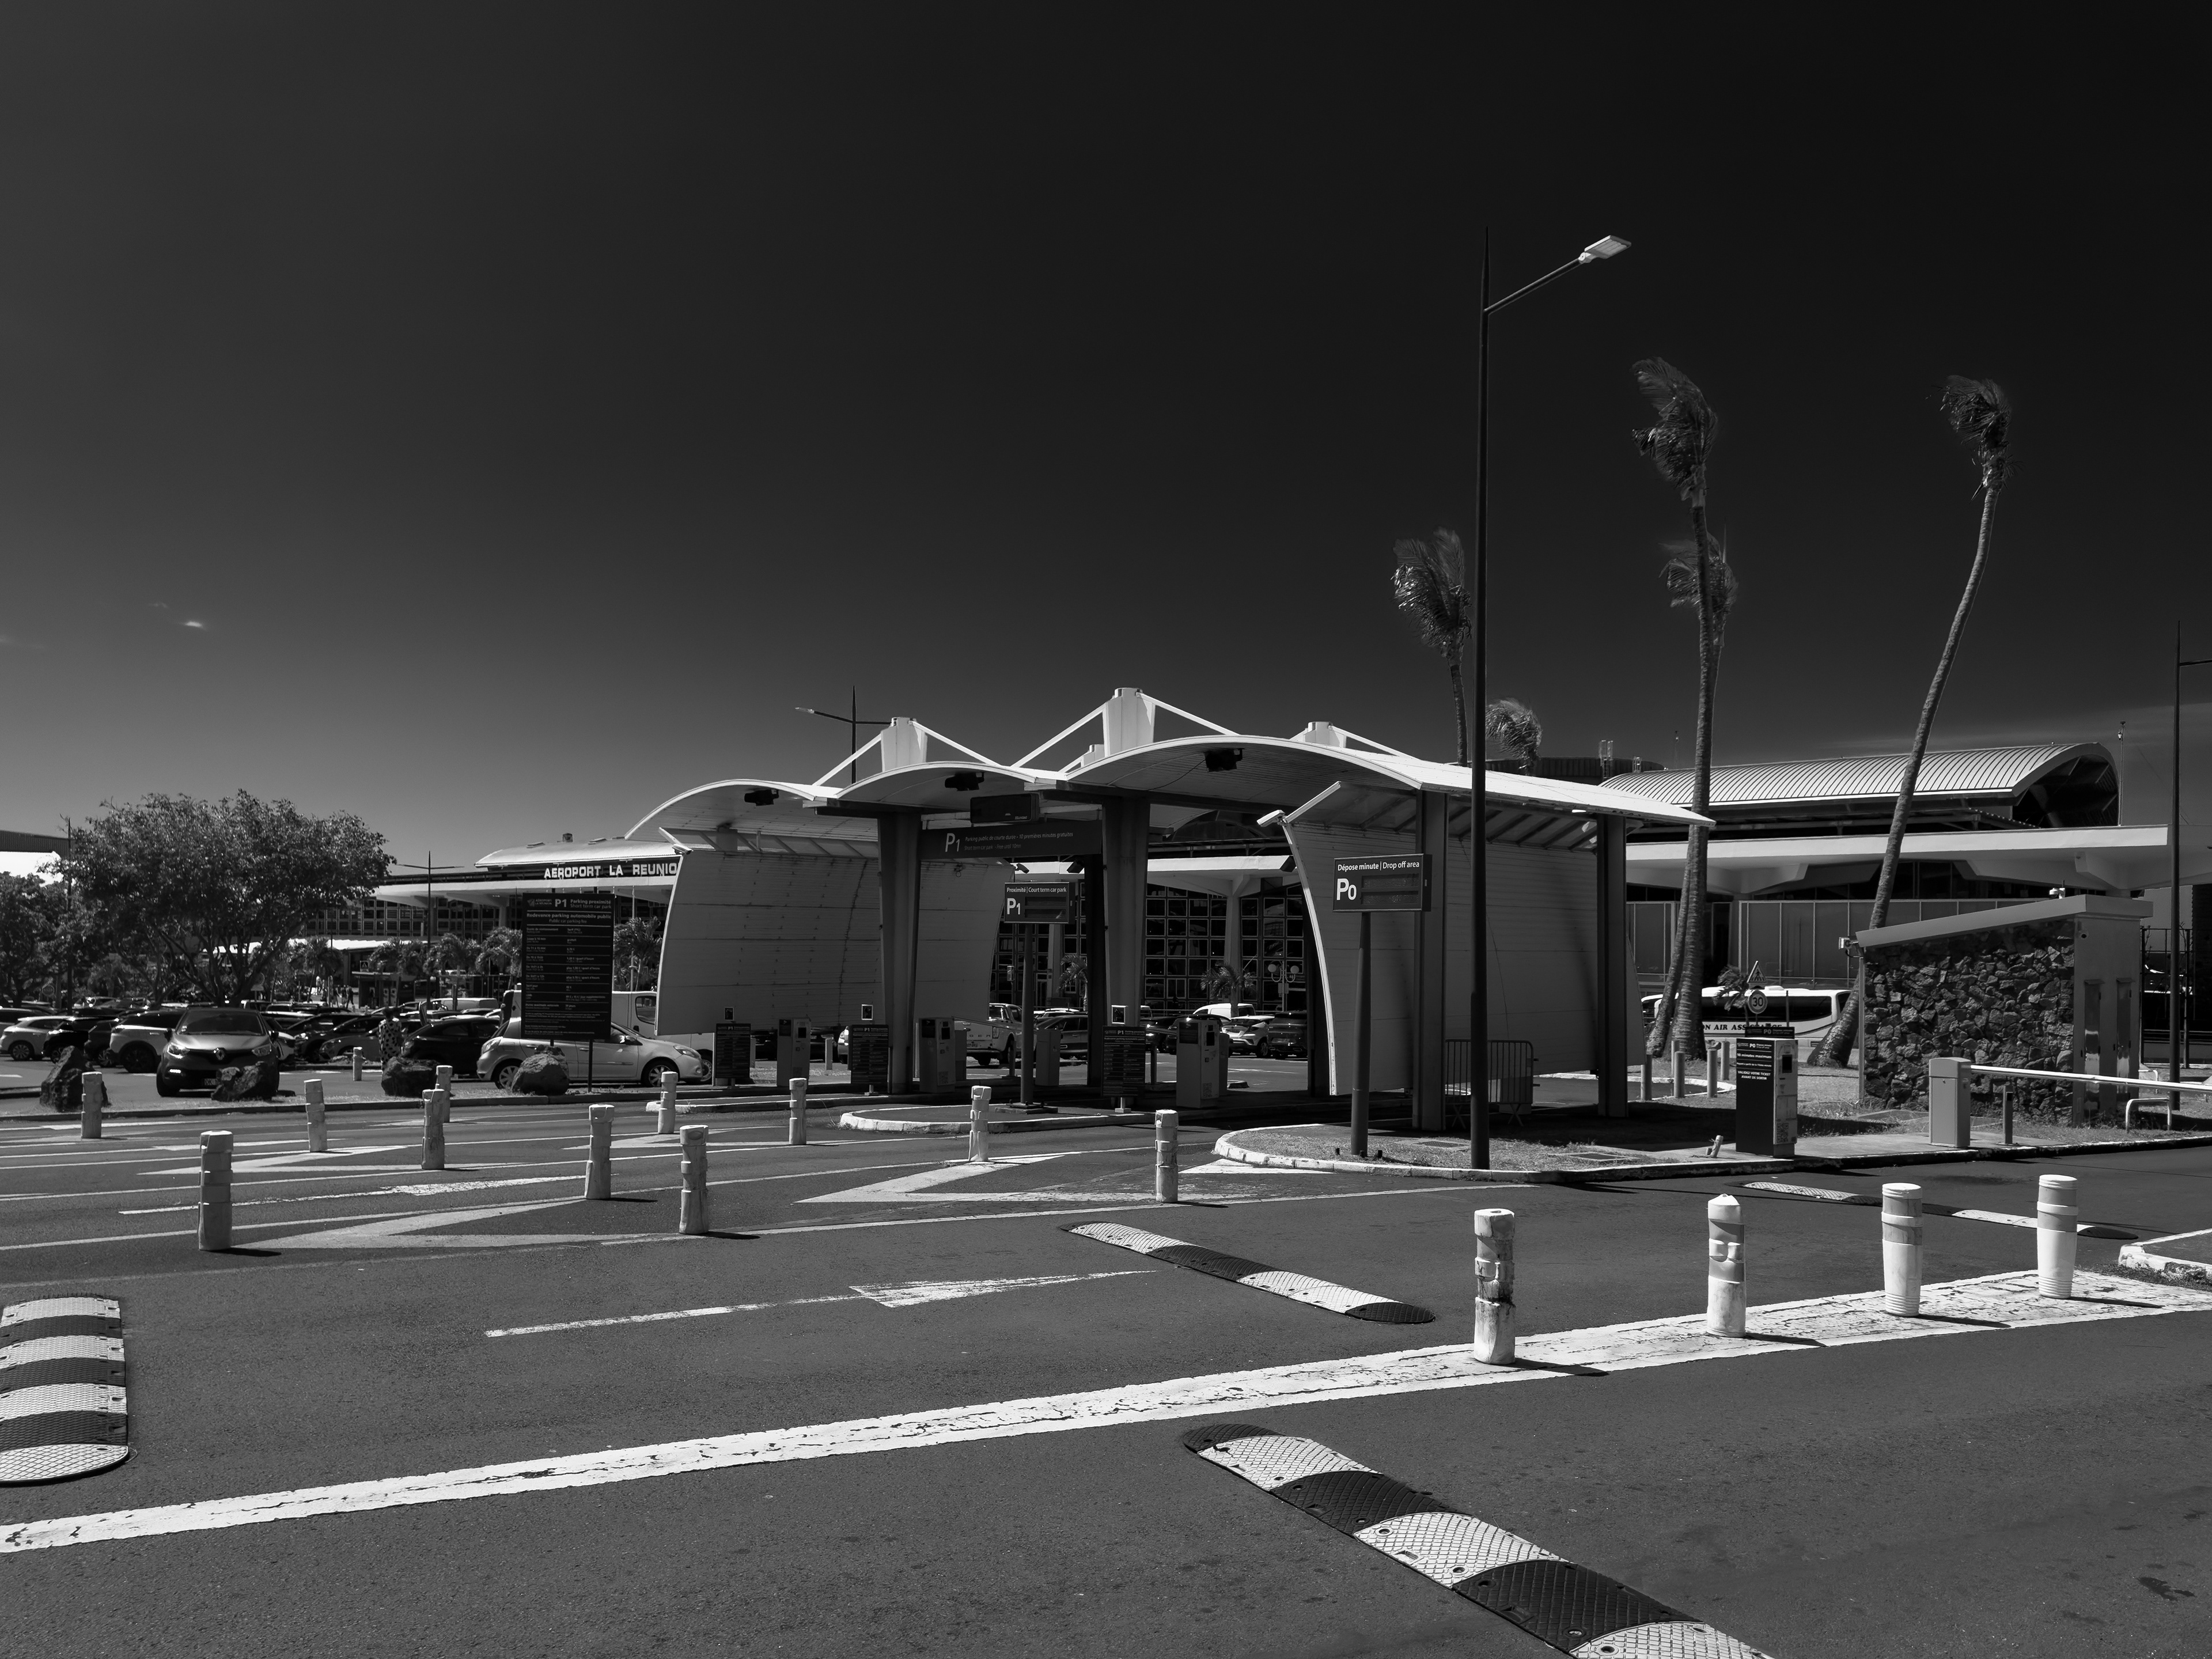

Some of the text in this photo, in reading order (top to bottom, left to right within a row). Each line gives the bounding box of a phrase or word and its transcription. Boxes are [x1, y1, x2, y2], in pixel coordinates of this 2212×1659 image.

[945, 833, 960, 852] P1
[544, 863, 677, 878] AEROPORT LA REUNIO
[1338, 864, 1358, 872] Dépose
[1359, 862, 1379, 870] minute
[1382, 862, 1397, 870] Drop
[555, 899, 567, 908] P1
[1007, 898, 1021, 915] P1
[1752, 997, 1763, 1007] 30
